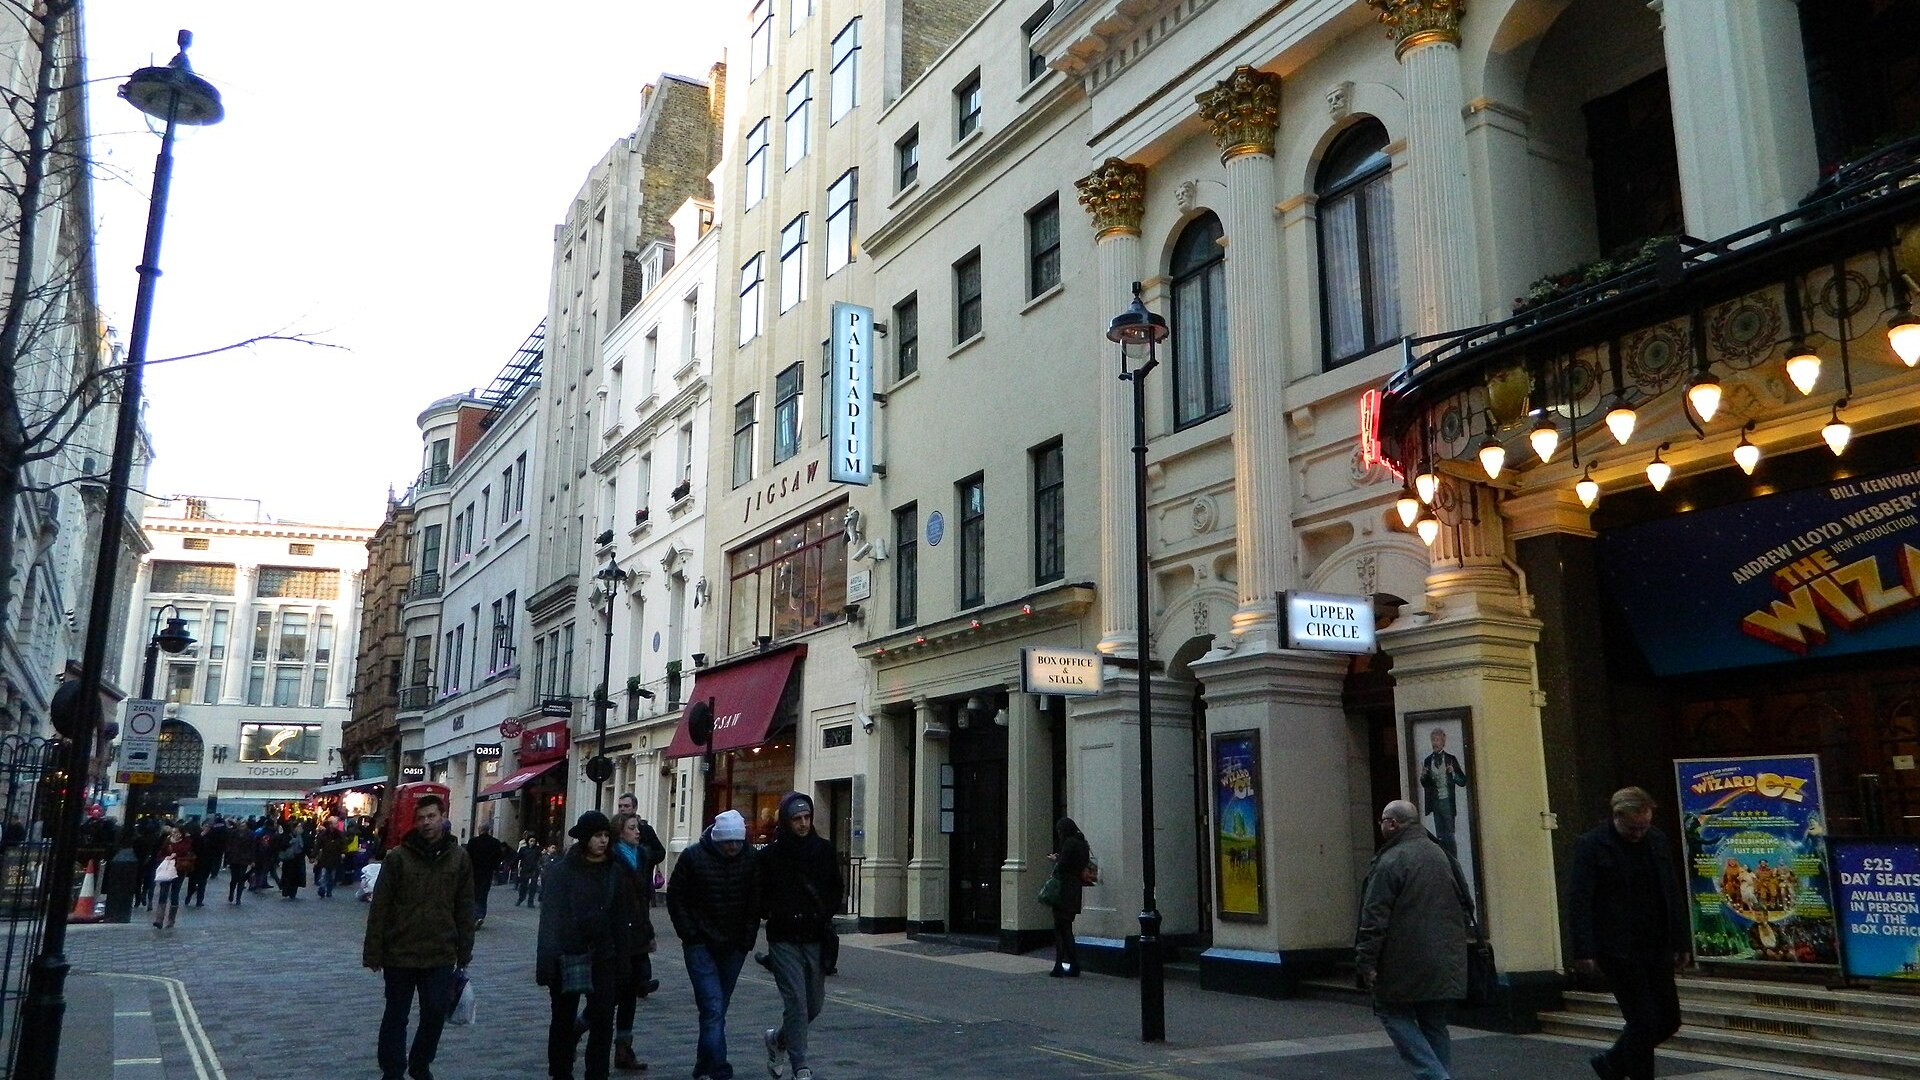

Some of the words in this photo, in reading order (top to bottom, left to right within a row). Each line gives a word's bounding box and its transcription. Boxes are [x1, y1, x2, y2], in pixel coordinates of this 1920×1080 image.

[844, 313, 861, 474] PALLADIUM
[744, 460, 819, 523] JIGSAW
[1829, 484, 1859, 500] BILL
[1731, 544, 1794, 585] ANDREW
[1791, 522, 1843, 552] LLOYD
[1842, 490, 1920, 529] WEBBER'
[1830, 537, 1854, 554] NEW
[1854, 514, 1919, 545] PRODUCTION
[1773, 549, 1840, 588] THE
[1310, 605, 1355, 621] UPPER
[1306, 622, 1360, 639] CIRCLE
[1037, 656, 1056, 666] BOX
[1058, 657, 1093, 667] OFFICE
[1048, 675, 1083, 684] STALLS
[713, 712, 741, 730] GSAW
[247, 767, 299, 776] TOPSHOP
[1691, 775, 1755, 794] WIZARD
[1756, 772, 1808, 802] OZ
[1863, 858, 1893, 870] £25
[1840, 873, 1871, 885] DAY
[1876, 873, 1920, 887] SEATS
[1851, 890, 1916, 902] AVAILABLE
[1850, 901, 1864, 912] IN
[1868, 902, 1919, 914] PERSON
[1865, 913, 1880, 924] AT
[1883, 914, 1906, 925] THE
[1851, 924, 1879, 935] BOX
[1882, 925, 1920, 937] OFFIC
